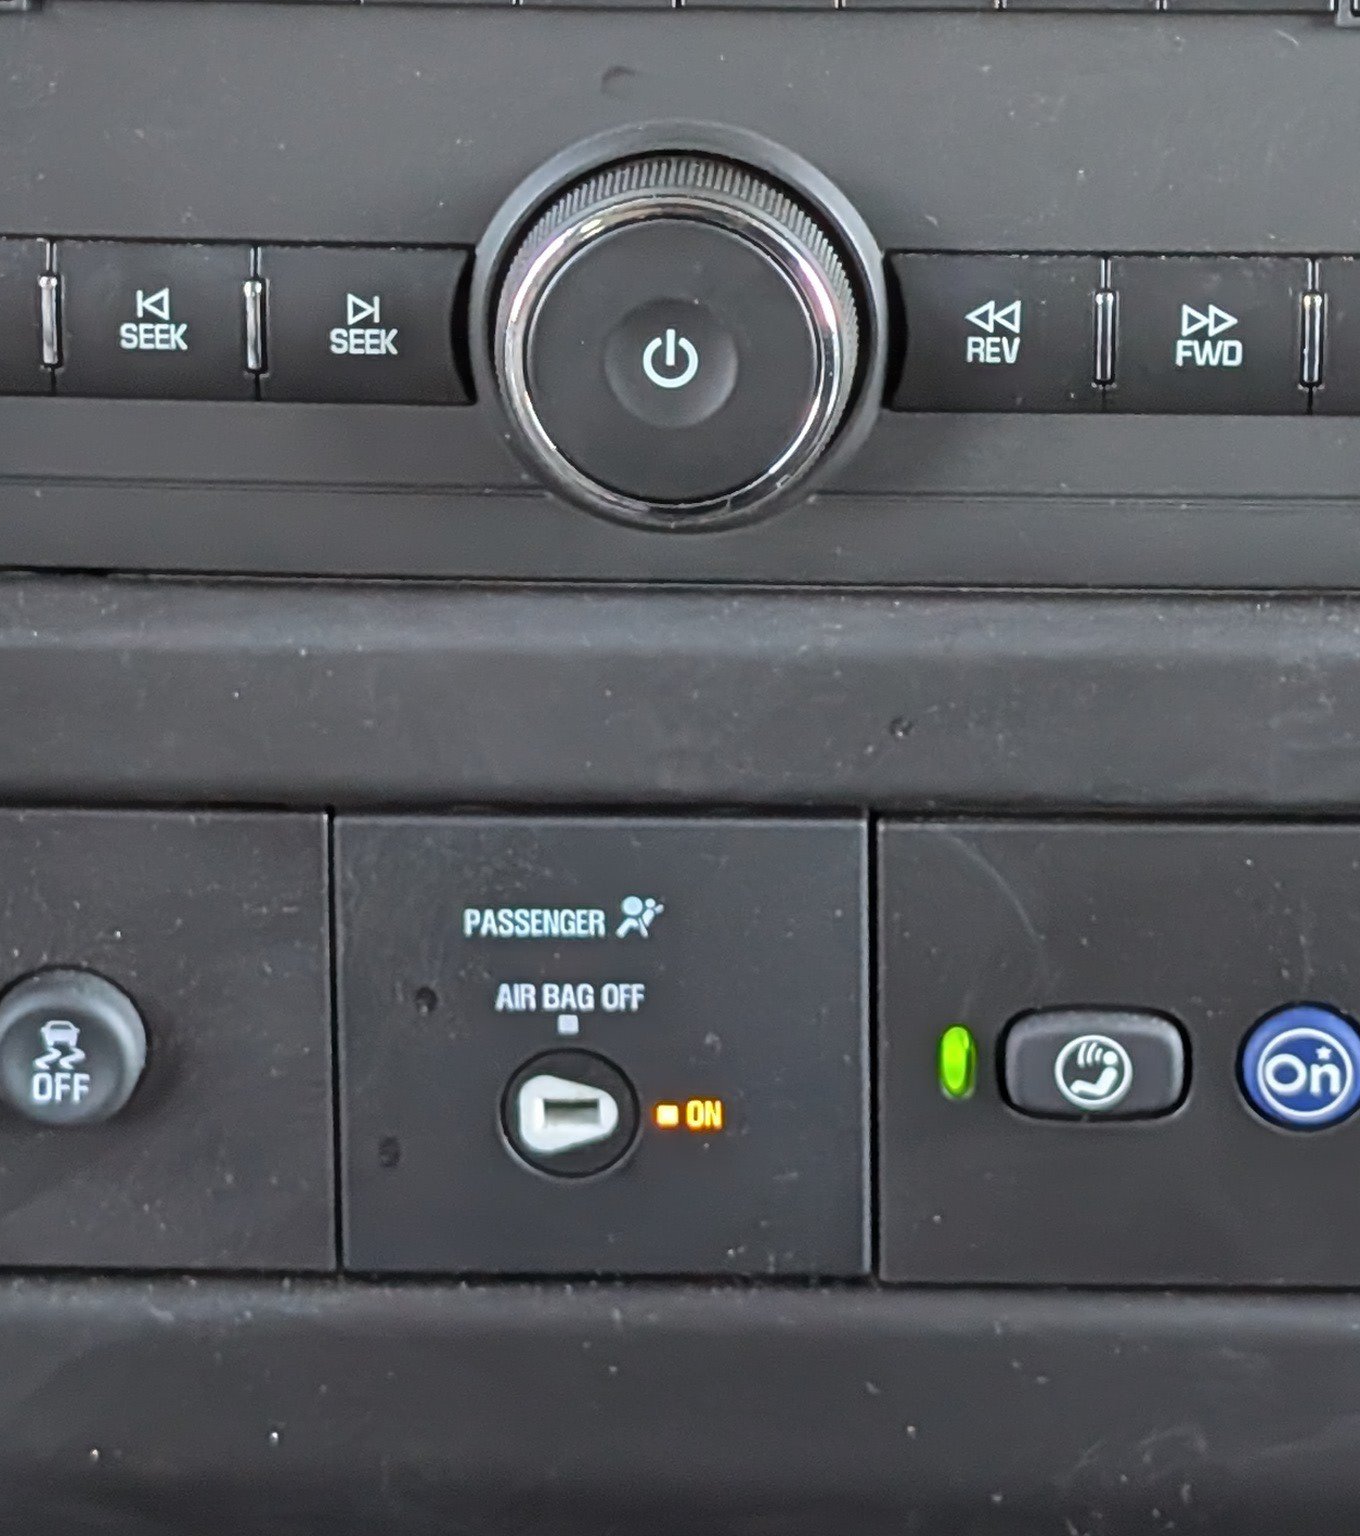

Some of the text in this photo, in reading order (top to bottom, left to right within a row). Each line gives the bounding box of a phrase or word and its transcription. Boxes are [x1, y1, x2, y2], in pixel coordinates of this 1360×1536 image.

[119, 322, 189, 351] SEEK
[329, 327, 399, 356] SEEK
[966, 335, 1021, 364] REV
[1175, 339, 1243, 367] FWD
[463, 908, 606, 938] PASSENGER
[495, 983, 645, 1012] AIR BAG OFF
[32, 1072, 90, 1104] OFF
[686, 1099, 722, 1129] ON
